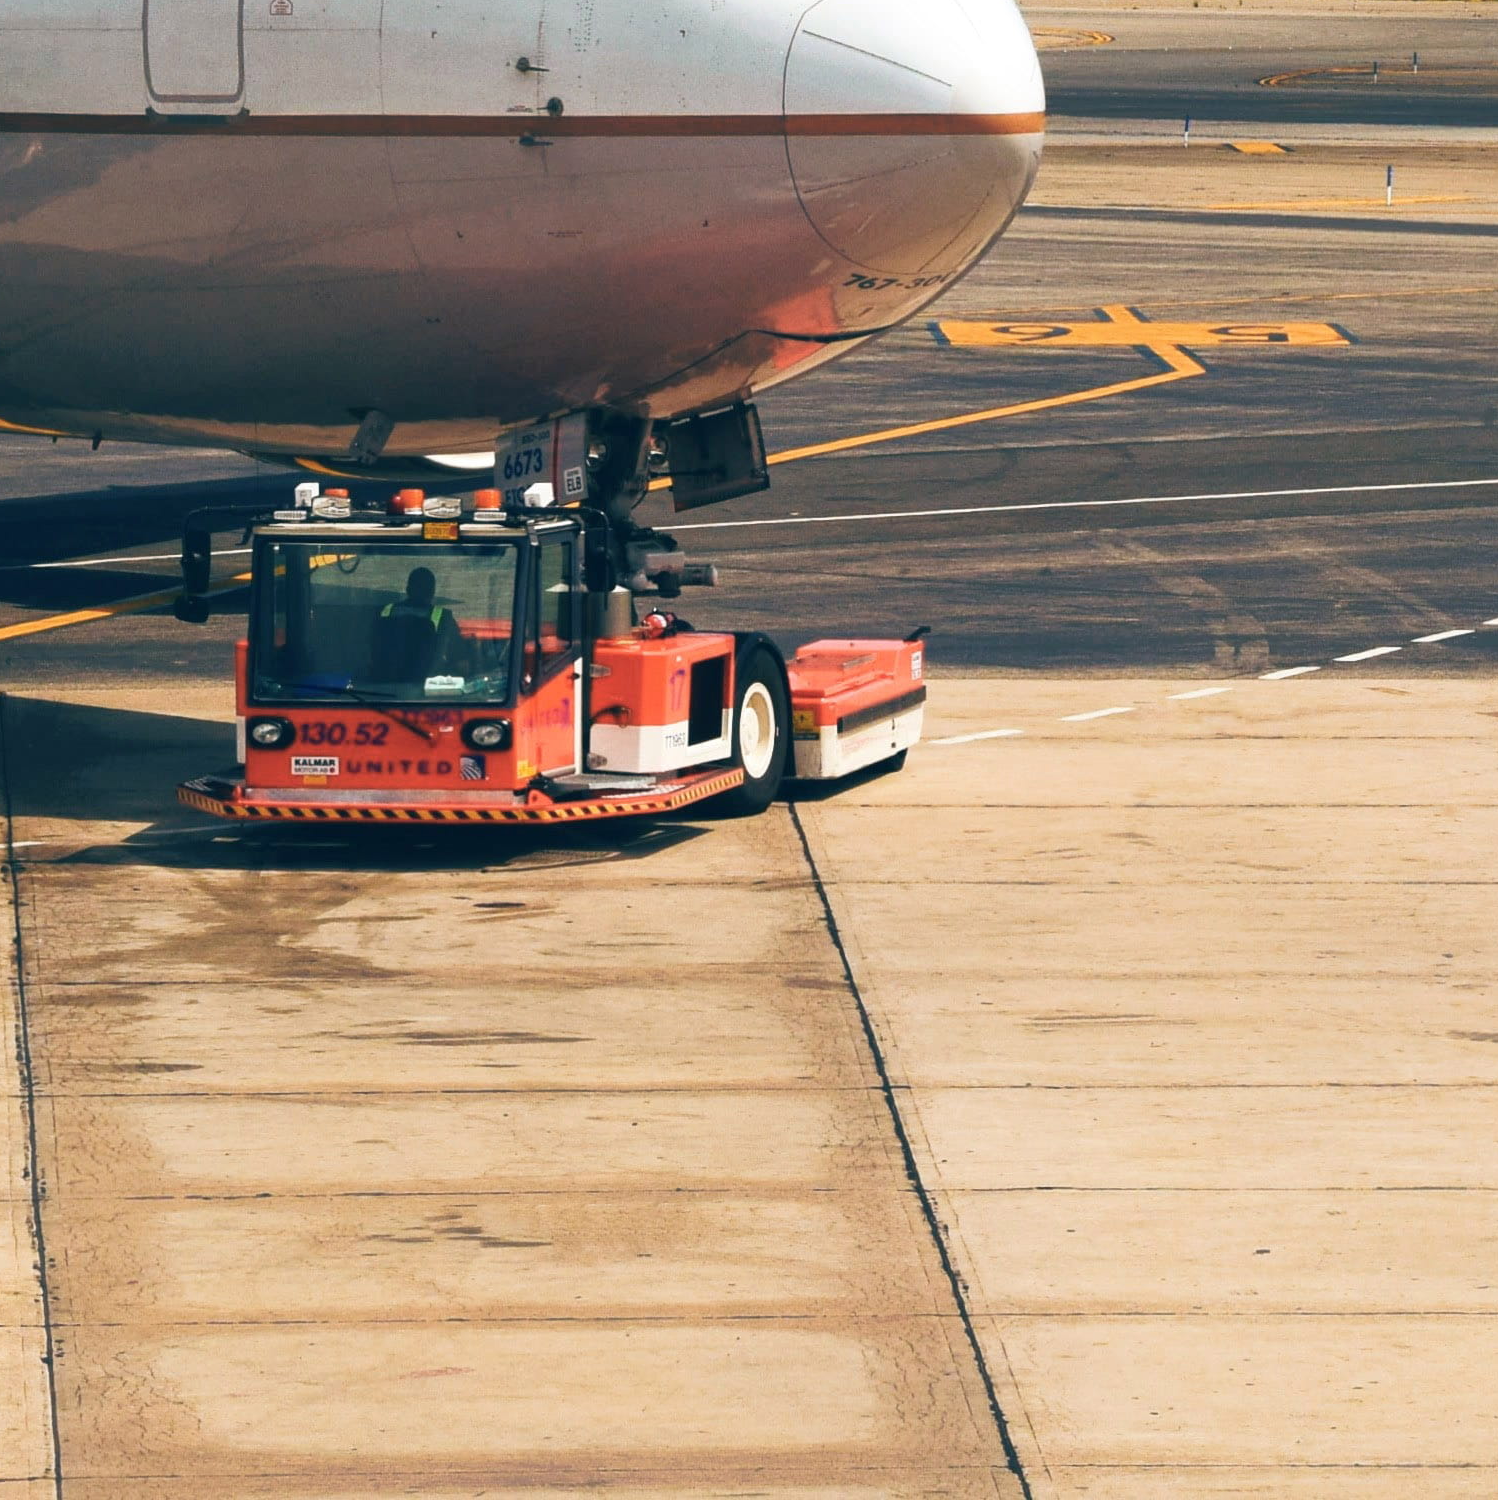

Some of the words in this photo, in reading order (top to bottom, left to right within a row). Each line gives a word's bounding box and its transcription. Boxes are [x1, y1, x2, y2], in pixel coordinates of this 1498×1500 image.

[504, 448, 543, 479] 6673
[567, 476, 582, 493] ELB
[299, 722, 390, 746] 130.52
[294, 758, 335, 767] KALMAR
[347, 760, 453, 774] UNITED
